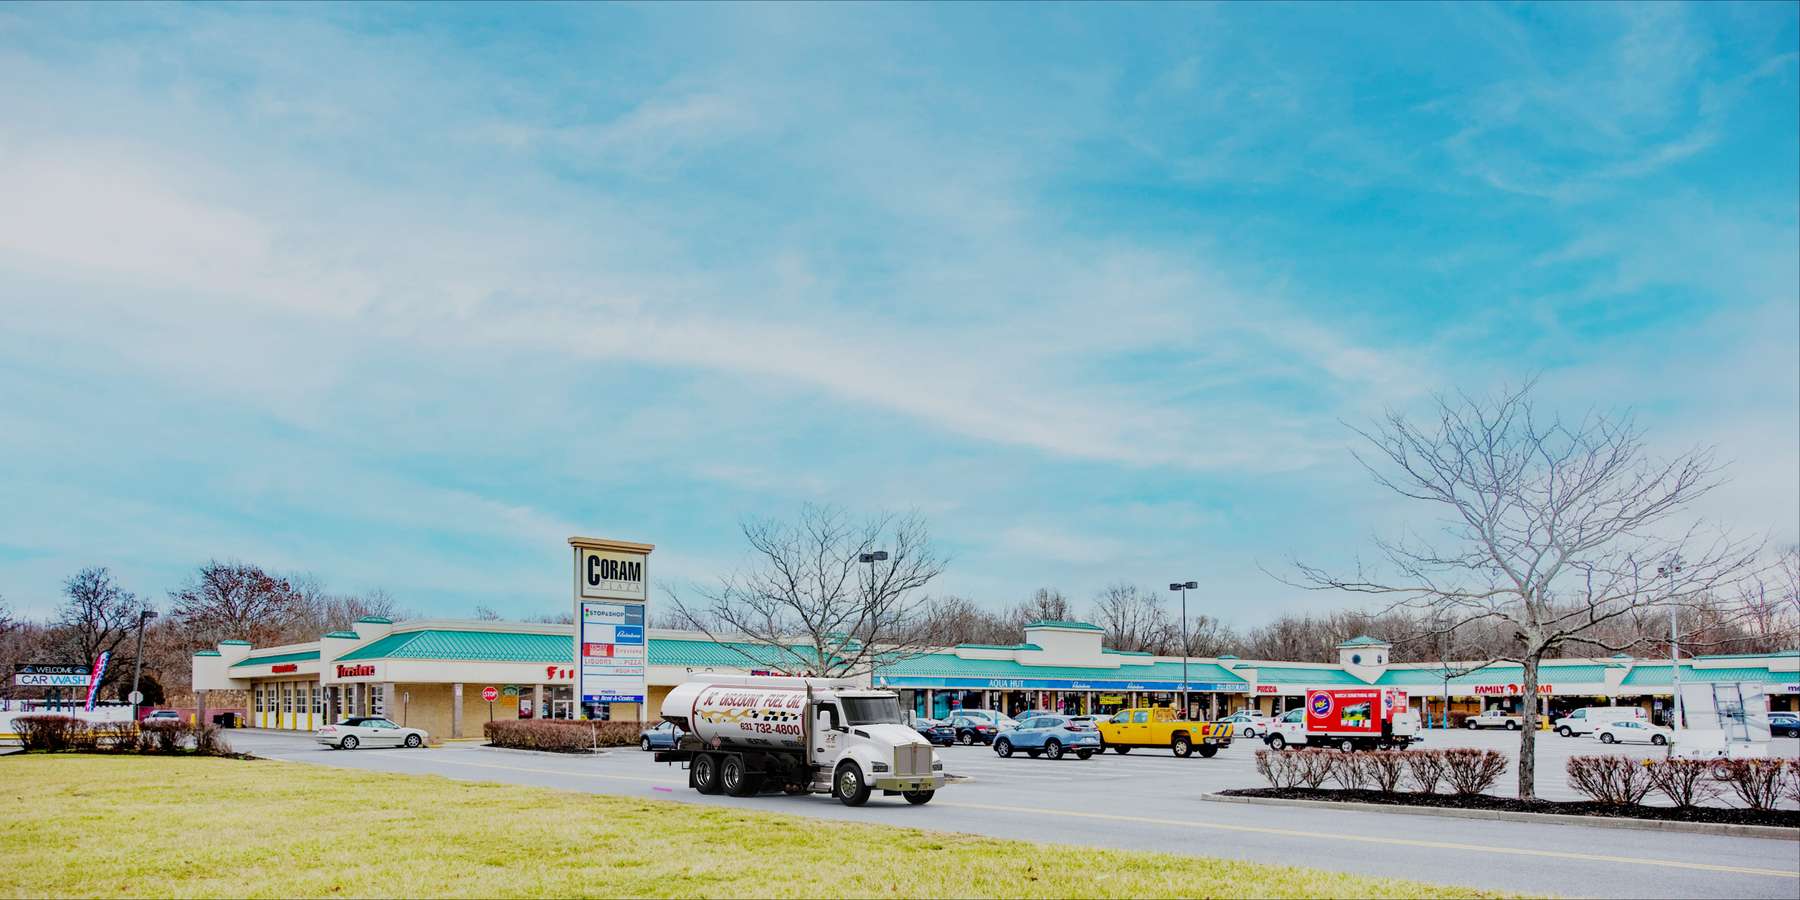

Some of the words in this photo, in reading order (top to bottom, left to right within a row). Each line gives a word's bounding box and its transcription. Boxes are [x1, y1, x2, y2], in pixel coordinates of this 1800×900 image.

[588, 555, 641, 586] CORAM
[36, 666, 72, 674] WELCOME
[21, 675, 48, 684] CAR
[50, 675, 87, 684] WASH
[988, 680, 1008, 688] AQUA
[1010, 680, 1024, 688] HUT
[1474, 685, 1505, 694] FAMILY
[720, 693, 763, 707] DISCOUNT
[763, 694, 788, 708] FUEL
[786, 695, 805, 709] OIL
[741, 722, 753, 731] 631
[755, 723, 800, 735] 732-4800
